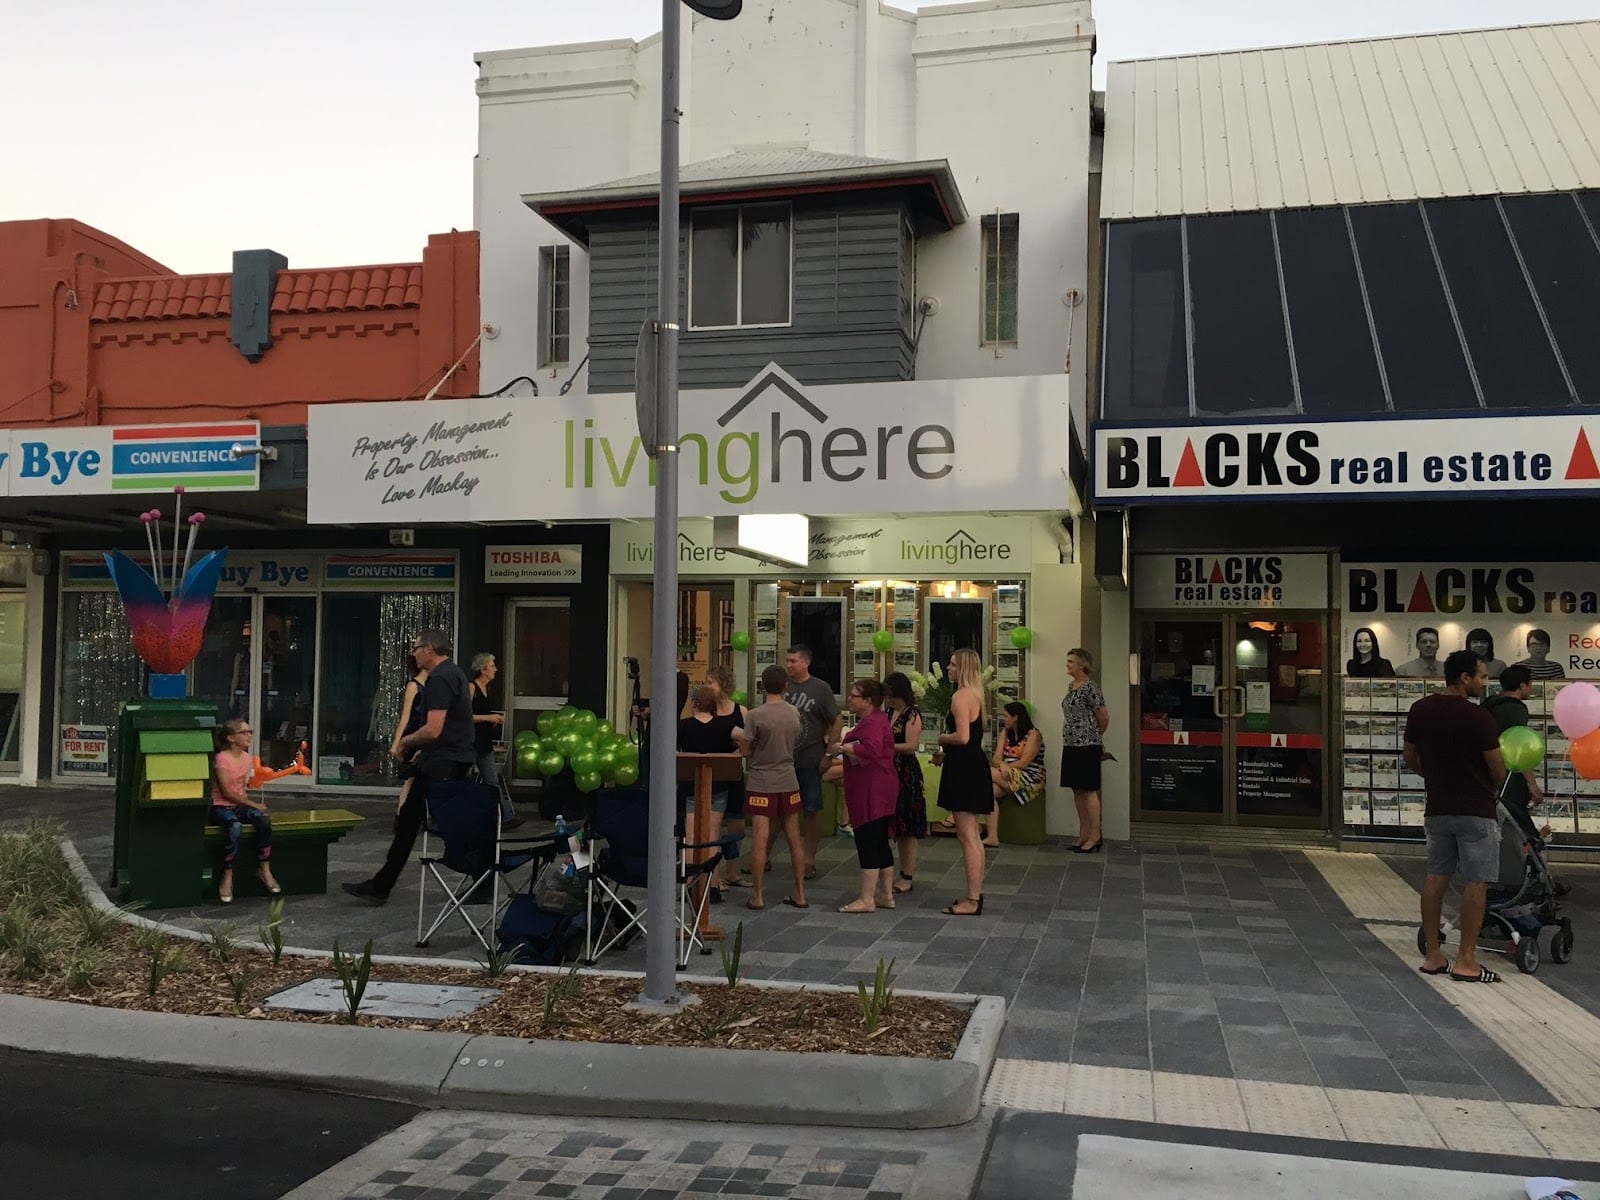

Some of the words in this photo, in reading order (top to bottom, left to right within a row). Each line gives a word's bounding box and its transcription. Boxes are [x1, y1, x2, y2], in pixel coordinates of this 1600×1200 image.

[352, 432, 418, 460] Property
[422, 412, 513, 444] Management
[20, 442, 100, 485] Bye
[365, 461, 379, 481] Is
[383, 457, 414, 478] Our
[1106, 430, 1321, 489] BLACKS
[1331, 451, 1408, 485] real
[1423, 451, 1552, 482] estate
[381, 485, 415, 504] Love
[419, 471, 480, 499] Mackay
[491, 551, 562, 564] TOSHIBA
[902, 540, 1011, 564] livinghere
[260, 561, 309, 587] Bye
[348, 566, 436, 577] CONVENIENCE
[490, 569, 520, 578] Leading
[522, 569, 562, 577] Innovation
[1175, 557, 1283, 585] BLACKS
[1175, 584, 1213, 600] real
[1220, 585, 1283, 600] estate
[1349, 568, 1536, 613] BLACKS
[64, 741, 82, 752] FOR
[84, 741, 106, 753] RENT
